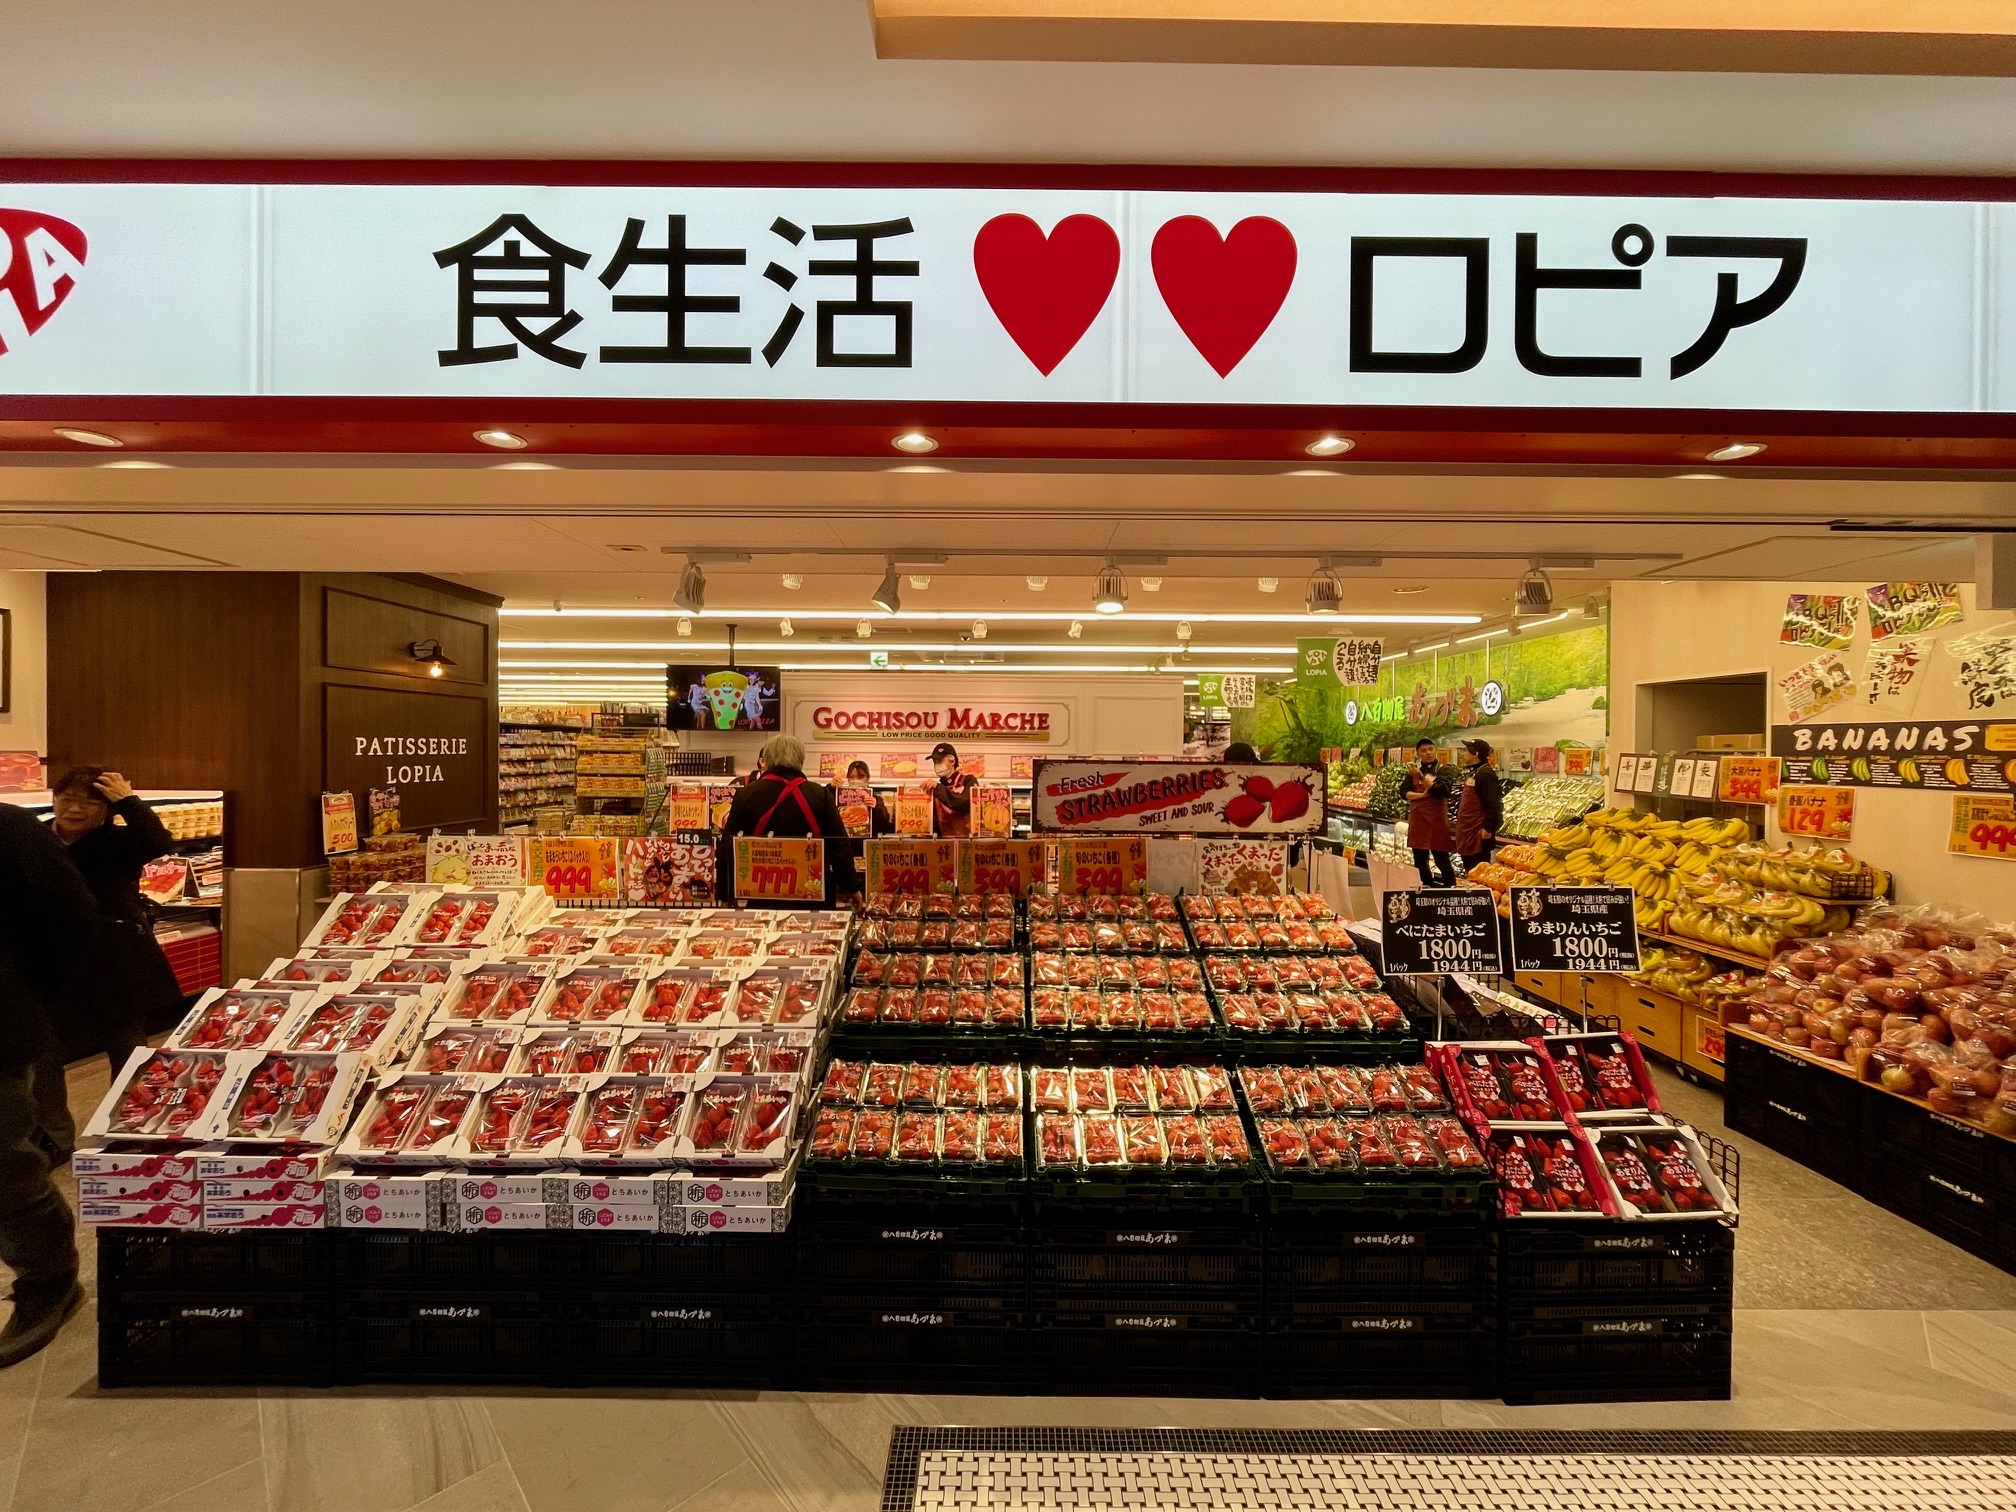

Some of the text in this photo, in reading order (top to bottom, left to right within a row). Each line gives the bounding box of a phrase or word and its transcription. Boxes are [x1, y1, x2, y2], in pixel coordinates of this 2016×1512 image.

[432, 213, 1808, 381] 食生活 ロピア
[1336, 641, 1347, 672] つくる
[813, 707, 1050, 731] GOCHISOU MARCHE
[355, 736, 467, 756] PATISSERIE
[1793, 725, 1980, 751] BANANAS
[386, 765, 444, 784] LOPIA
[1058, 771, 1105, 793] Fresh
[1061, 767, 1227, 821] STRAWBERRIES
[1138, 802, 1215, 828] SWEET AND SOUR
[1789, 807, 1826, 832] 129
[675, 819, 698, 829] 999
[900, 820, 923, 829] 999
[331, 832, 354, 845] 500
[678, 834, 700, 844] 15.0
[471, 854, 518, 868] あまおう
[1204, 853, 1242, 869] くまった
[1236, 844, 1283, 862] くまった
[545, 865, 592, 894] 999
[751, 865, 798, 895] 777
[882, 868, 930, 894] 399
[974, 868, 1021, 894] 399
[1075, 866, 1123, 895] 399
[1437, 906, 1474, 916] 埼玉県産
[1571, 904, 1609, 915] 埼玉県産
[1395, 922, 1487, 938] べにたまいちご
[1527, 920, 1622, 936] あまりんいちご
[1389, 962, 1409, 973] 1パック
[1520, 959, 1541, 969] 1パック
[1615, 1166, 1644, 1177] あまりん
[1666, 1164, 1695, 1175] あまりん
[383, 1188, 421, 1196] とちあいか
[500, 1187, 537, 1195] とちあいか
[611, 1188, 649, 1196] とちあいか
[725, 1190, 763, 1198] とちあいか
[384, 1211, 421, 1219] とちあいか
[616, 1213, 654, 1221] とちあいか
[729, 1216, 767, 1224] とちあいか
